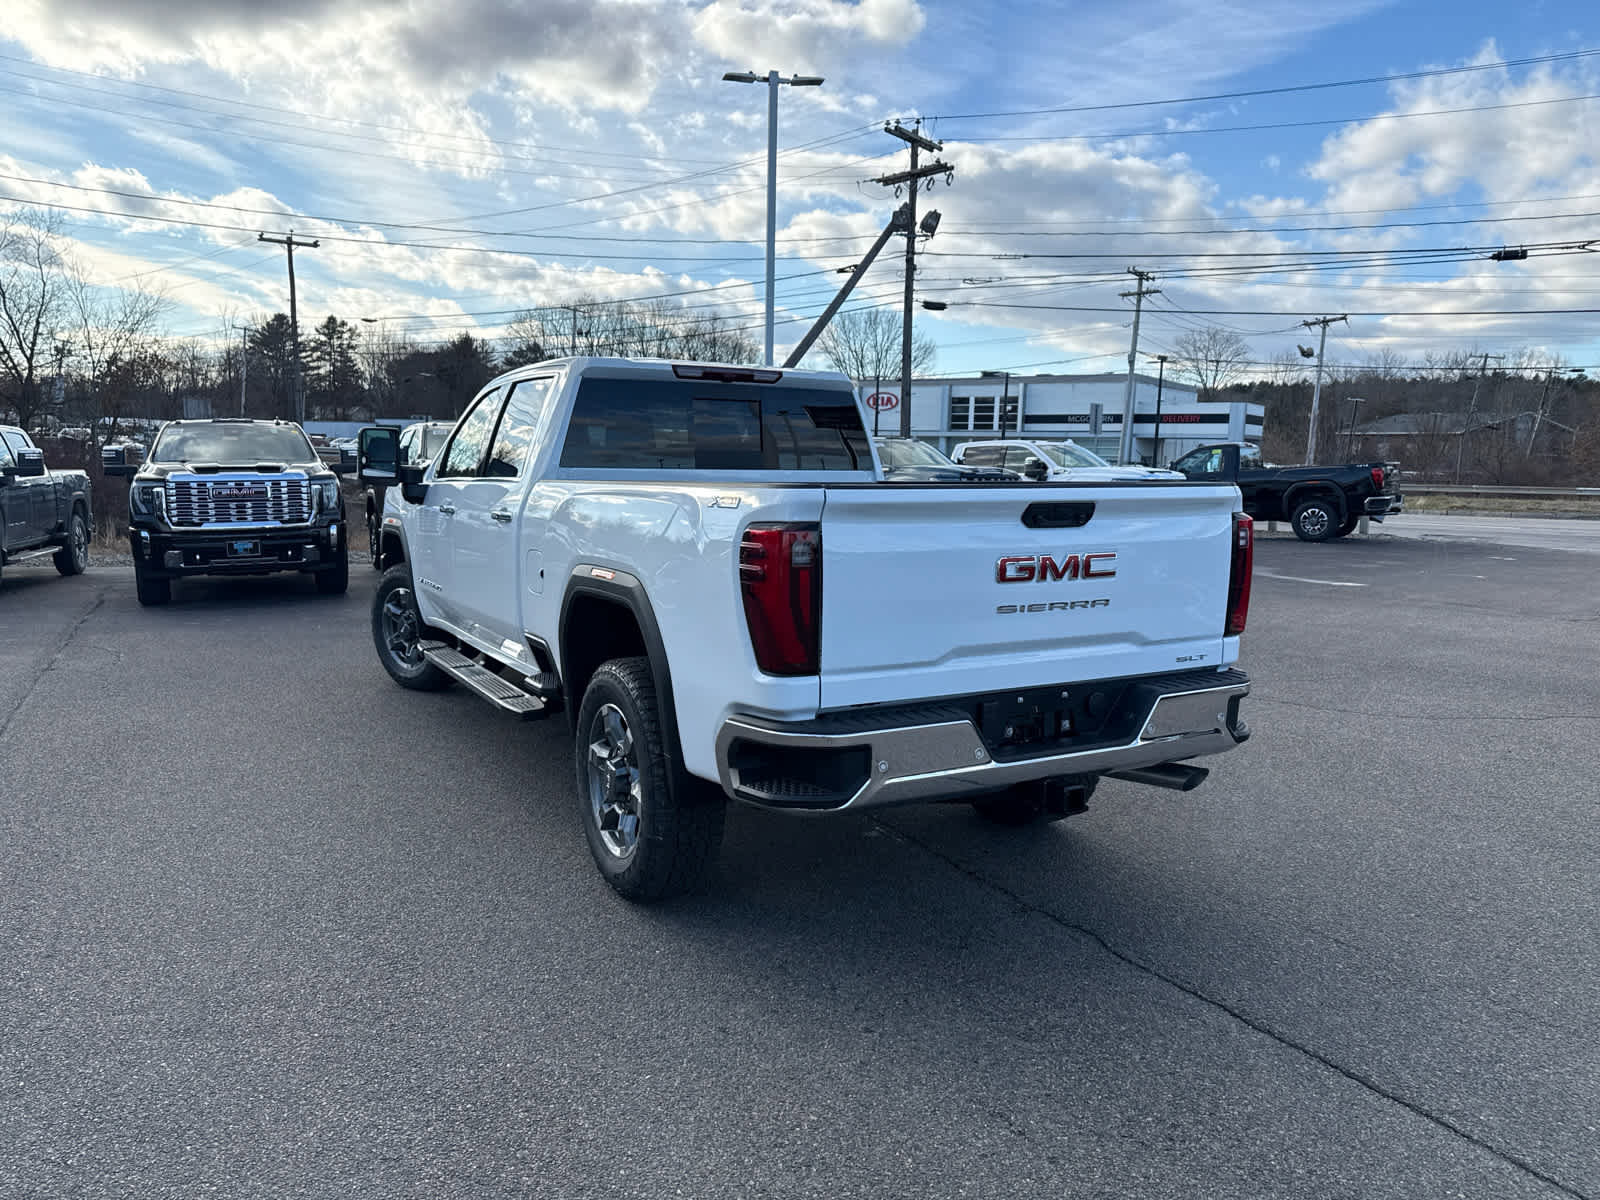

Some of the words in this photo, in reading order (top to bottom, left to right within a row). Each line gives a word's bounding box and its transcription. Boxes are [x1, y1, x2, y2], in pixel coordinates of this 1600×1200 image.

[1162, 415, 1201, 424] DELIVERY
[996, 552, 1117, 583] GMC
[996, 599, 1111, 614] SIERRA
[1175, 654, 1208, 663] SLT
